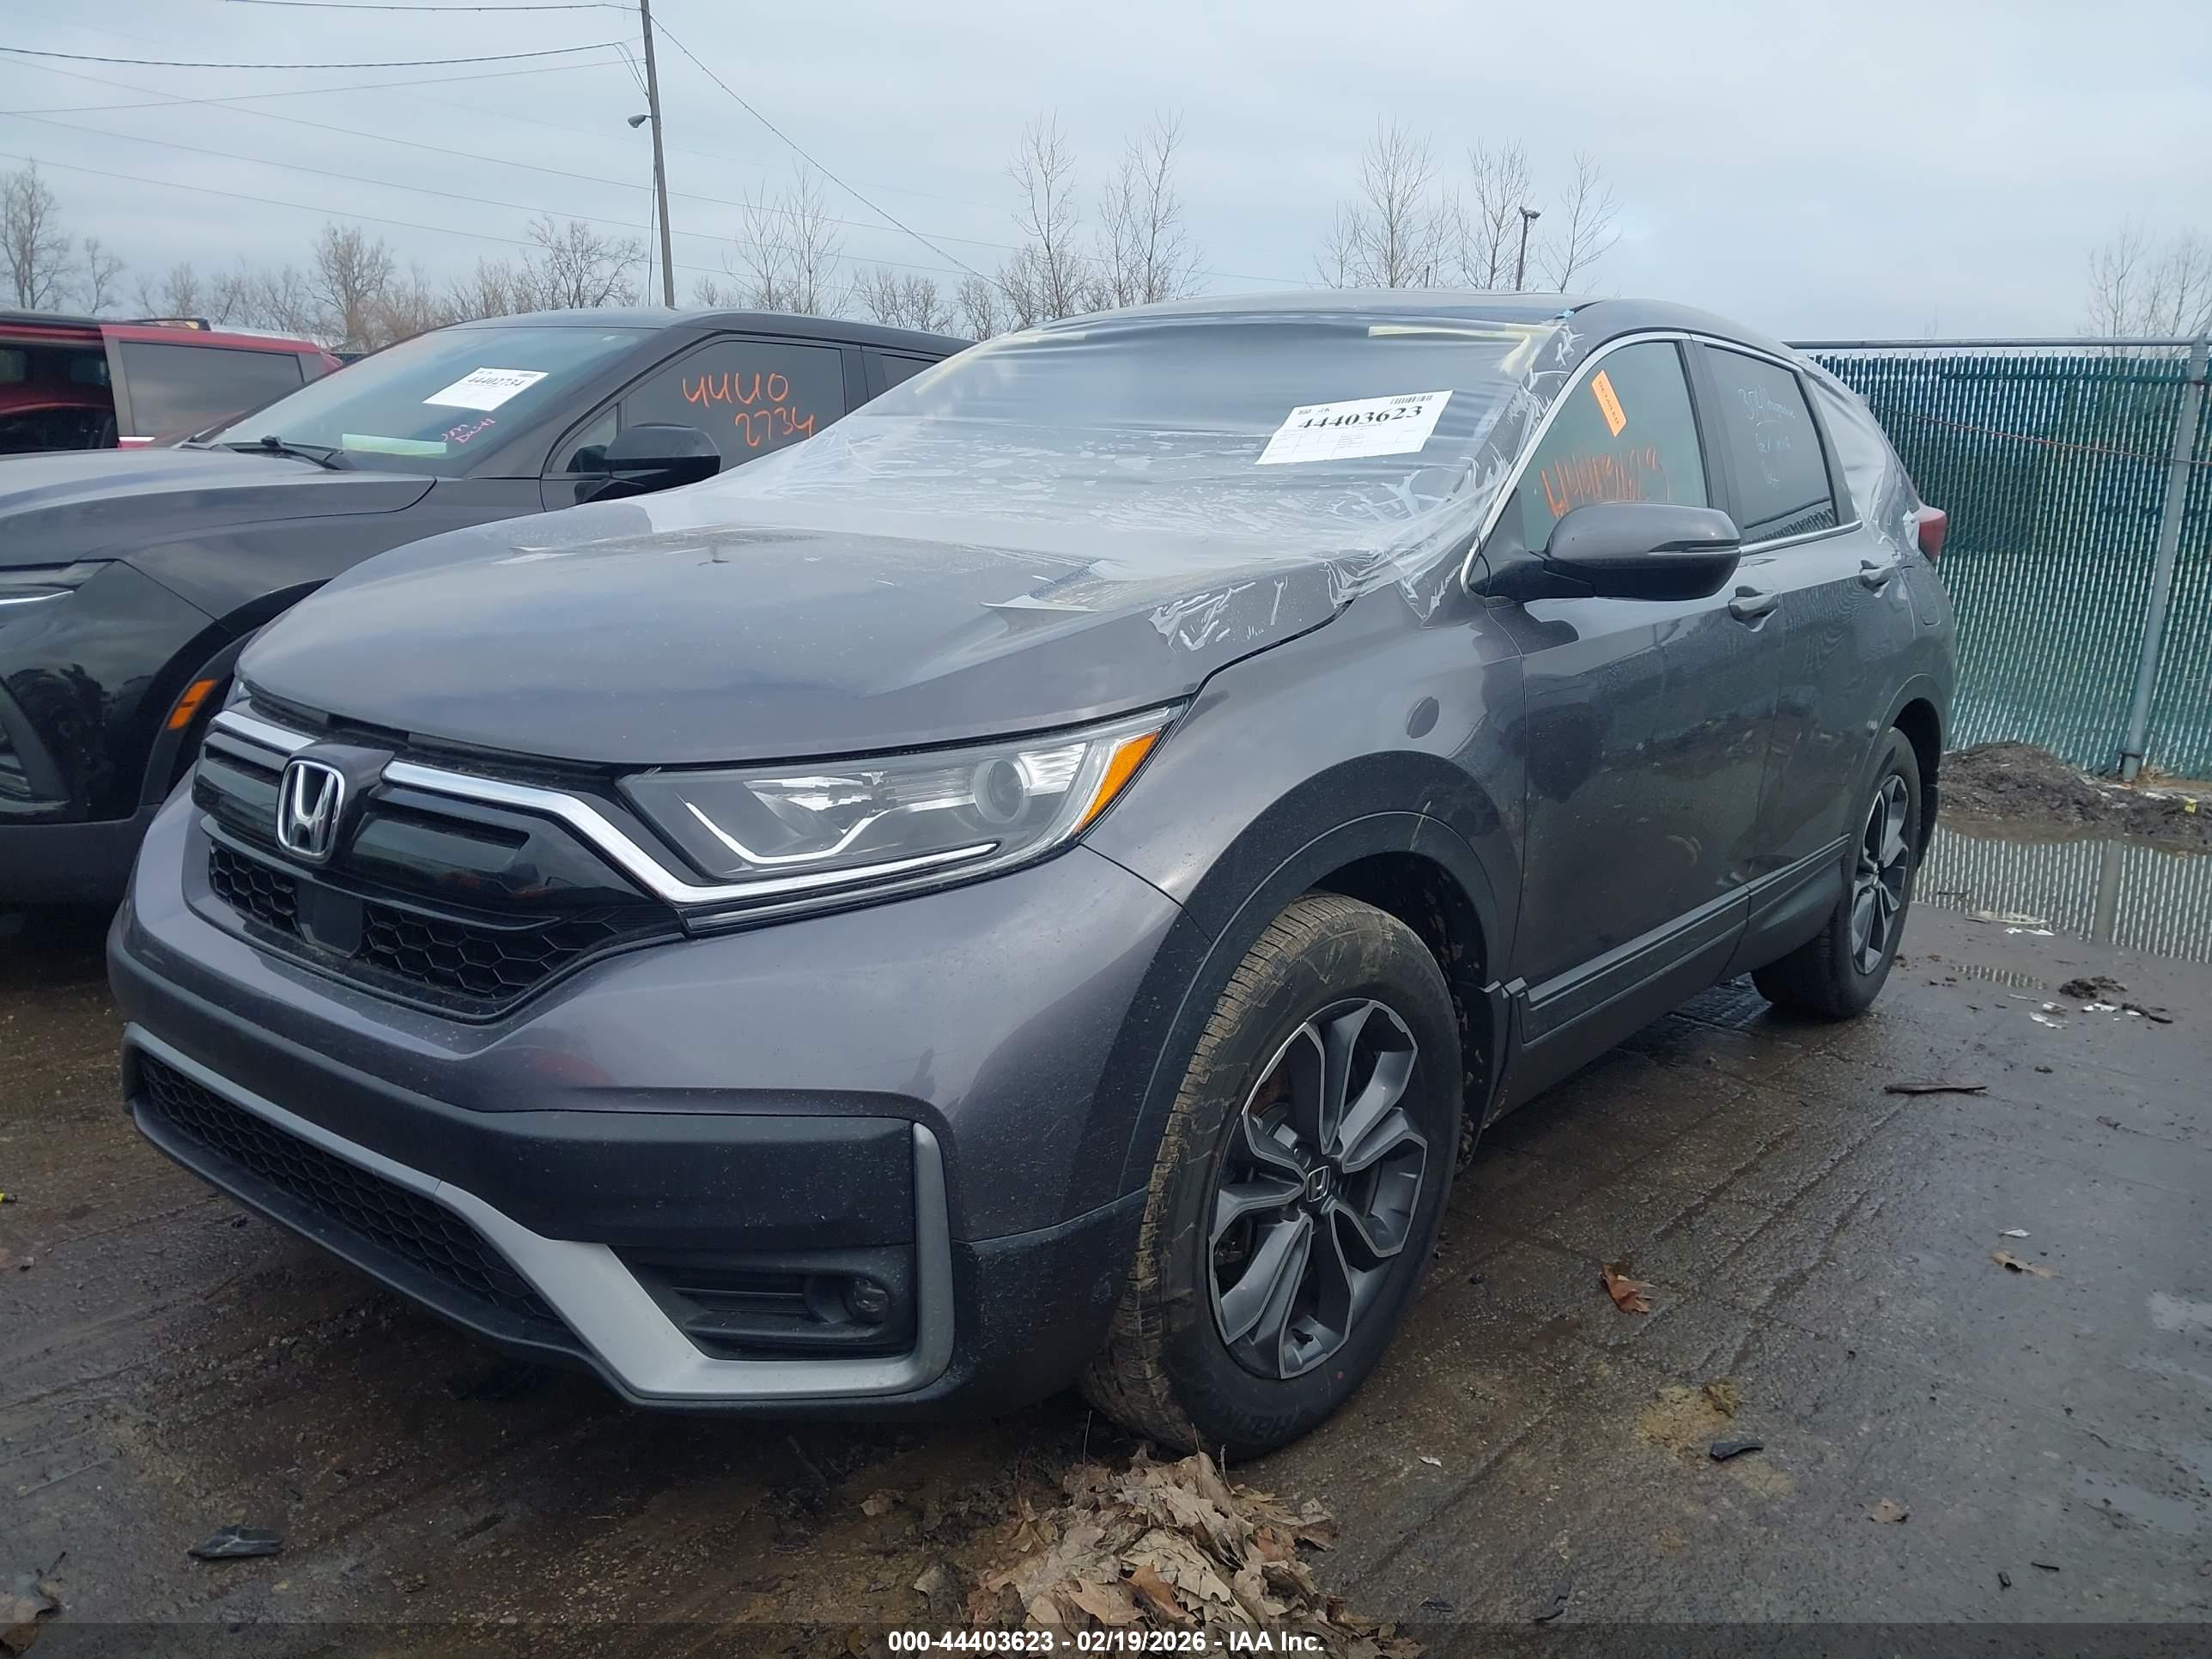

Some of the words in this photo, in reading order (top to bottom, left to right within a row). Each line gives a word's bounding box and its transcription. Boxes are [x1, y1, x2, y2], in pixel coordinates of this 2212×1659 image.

[468, 376, 526, 387] 44402734
[734, 405, 816, 447] 2734
[1297, 405, 1423, 428] 44403623
